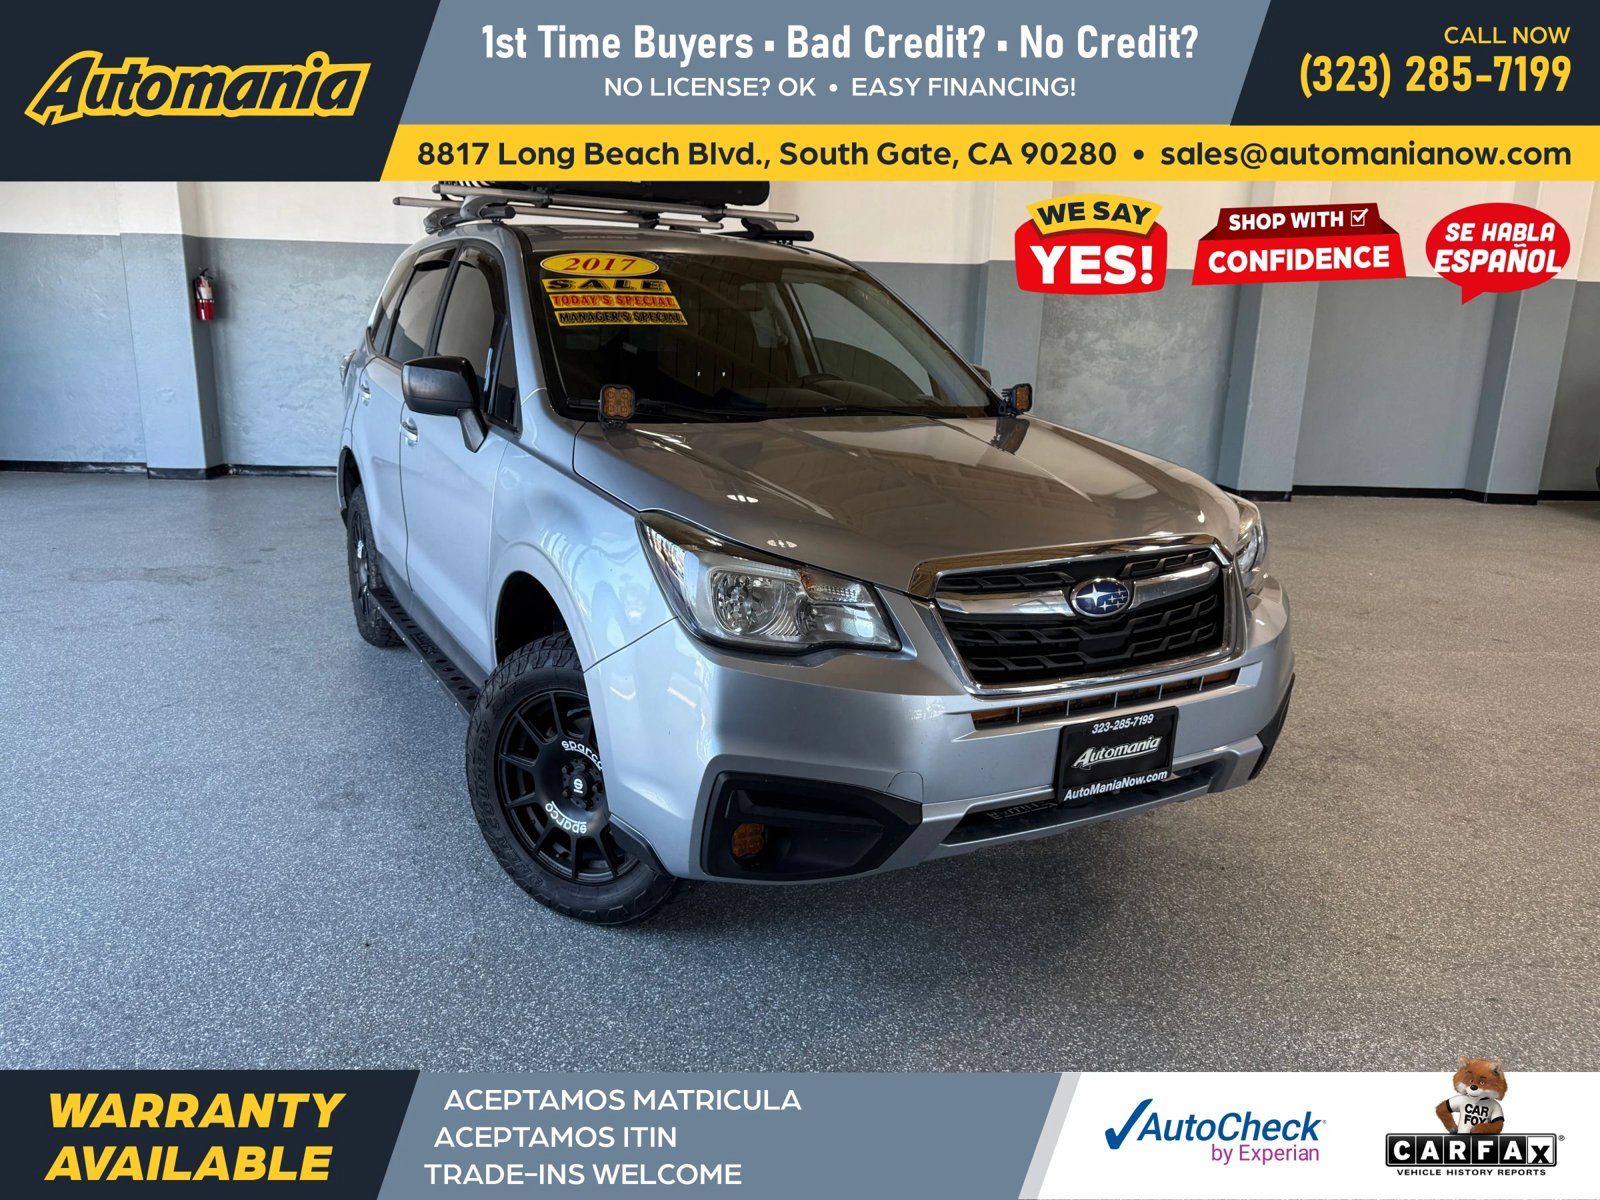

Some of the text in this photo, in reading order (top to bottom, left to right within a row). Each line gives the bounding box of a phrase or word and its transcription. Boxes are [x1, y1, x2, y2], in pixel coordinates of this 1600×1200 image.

[562, 257, 638, 272] 2017
[546, 279, 667, 292] SALE
[552, 295, 678, 308] TODAY'S SPECIAL
[558, 311, 687, 325] MANAGER'S SPECIAL
[1091, 713, 1154, 735] 323-285-7199
[1071, 736, 1163, 768] Automania
[1063, 770, 1168, 801] AutoManiaNow.com
[545, 802, 587, 834] sparco
